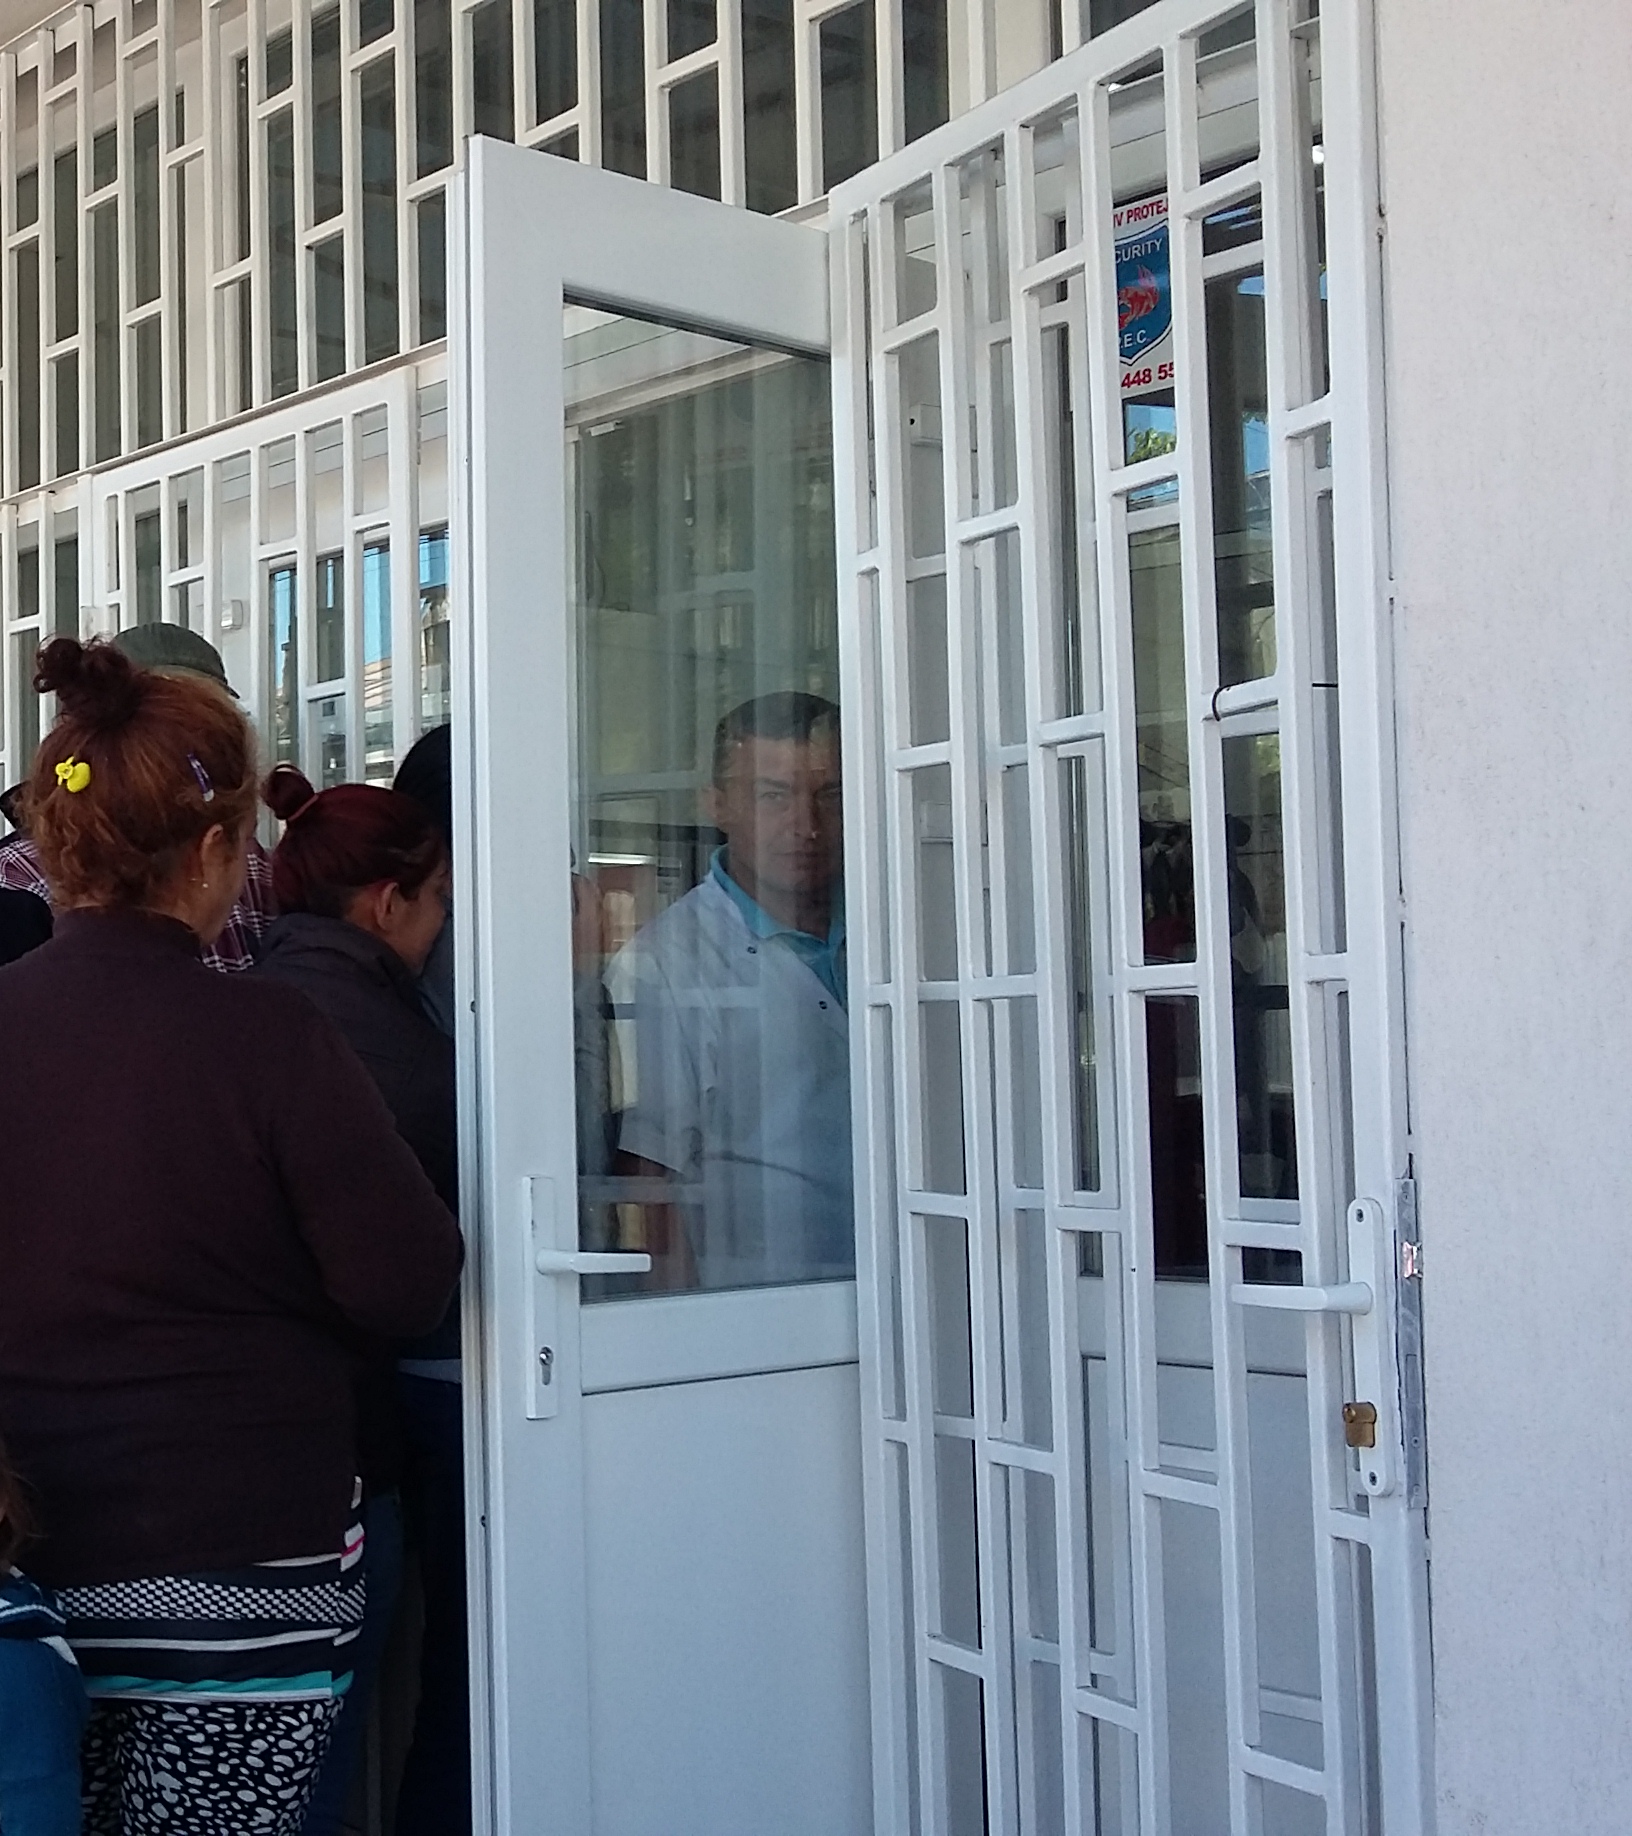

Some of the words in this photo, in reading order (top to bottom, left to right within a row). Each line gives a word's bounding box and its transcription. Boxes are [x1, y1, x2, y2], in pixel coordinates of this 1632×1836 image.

[1126, 198, 1169, 224] PROTEJ
[1114, 237, 1163, 264] CURITY
[1120, 368, 1152, 389] 448
